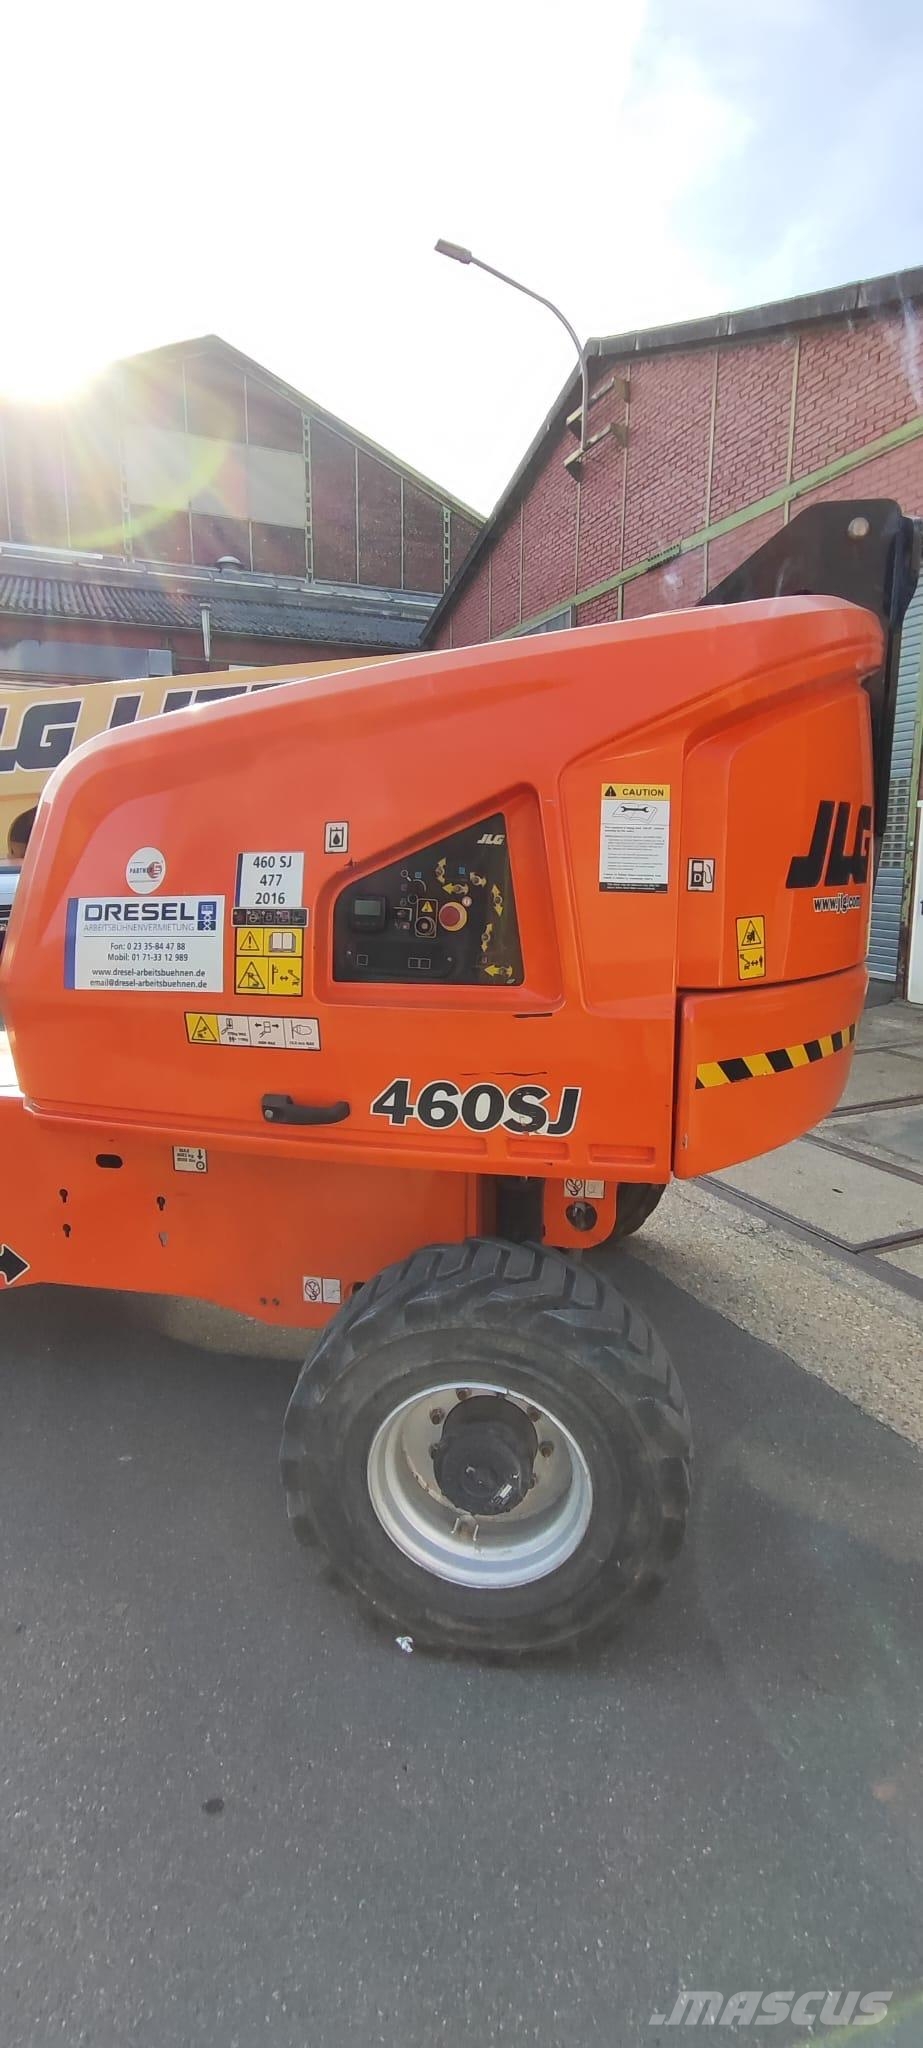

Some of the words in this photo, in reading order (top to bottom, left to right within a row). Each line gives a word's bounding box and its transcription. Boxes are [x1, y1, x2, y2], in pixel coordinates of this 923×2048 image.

[622, 788, 664, 797] CAUTION
[477, 833, 506, 845] JLG
[785, 800, 872, 888] JLG
[253, 855, 276, 869] 460
[280, 855, 292, 869] SJ
[260, 873, 283, 887] 477
[693, 873, 702, 883] D
[255, 892, 286, 905] 2016
[813, 893, 861, 914] www.jlg.com
[84, 902, 195, 921] DRESEL
[110, 942, 126, 951] Fon:
[127, 942, 132, 951] 0
[133, 942, 142, 951] 23
[144, 942, 164, 951] 35-84
[165, 942, 175, 951] 47
[176, 943, 186, 951] 88
[107, 953, 130, 961] Mobil:
[131, 953, 140, 961] 01
[142, 953, 162, 962] 71-33
[164, 954, 173, 962] 12
[175, 954, 189, 962] 989
[92, 967, 206, 978] www.dresel-arbeitsbuehnen.de
[90, 978, 208, 989] email@dresel-arbeitsbuehnen.de
[370, 1078, 582, 1137] 460SJ
